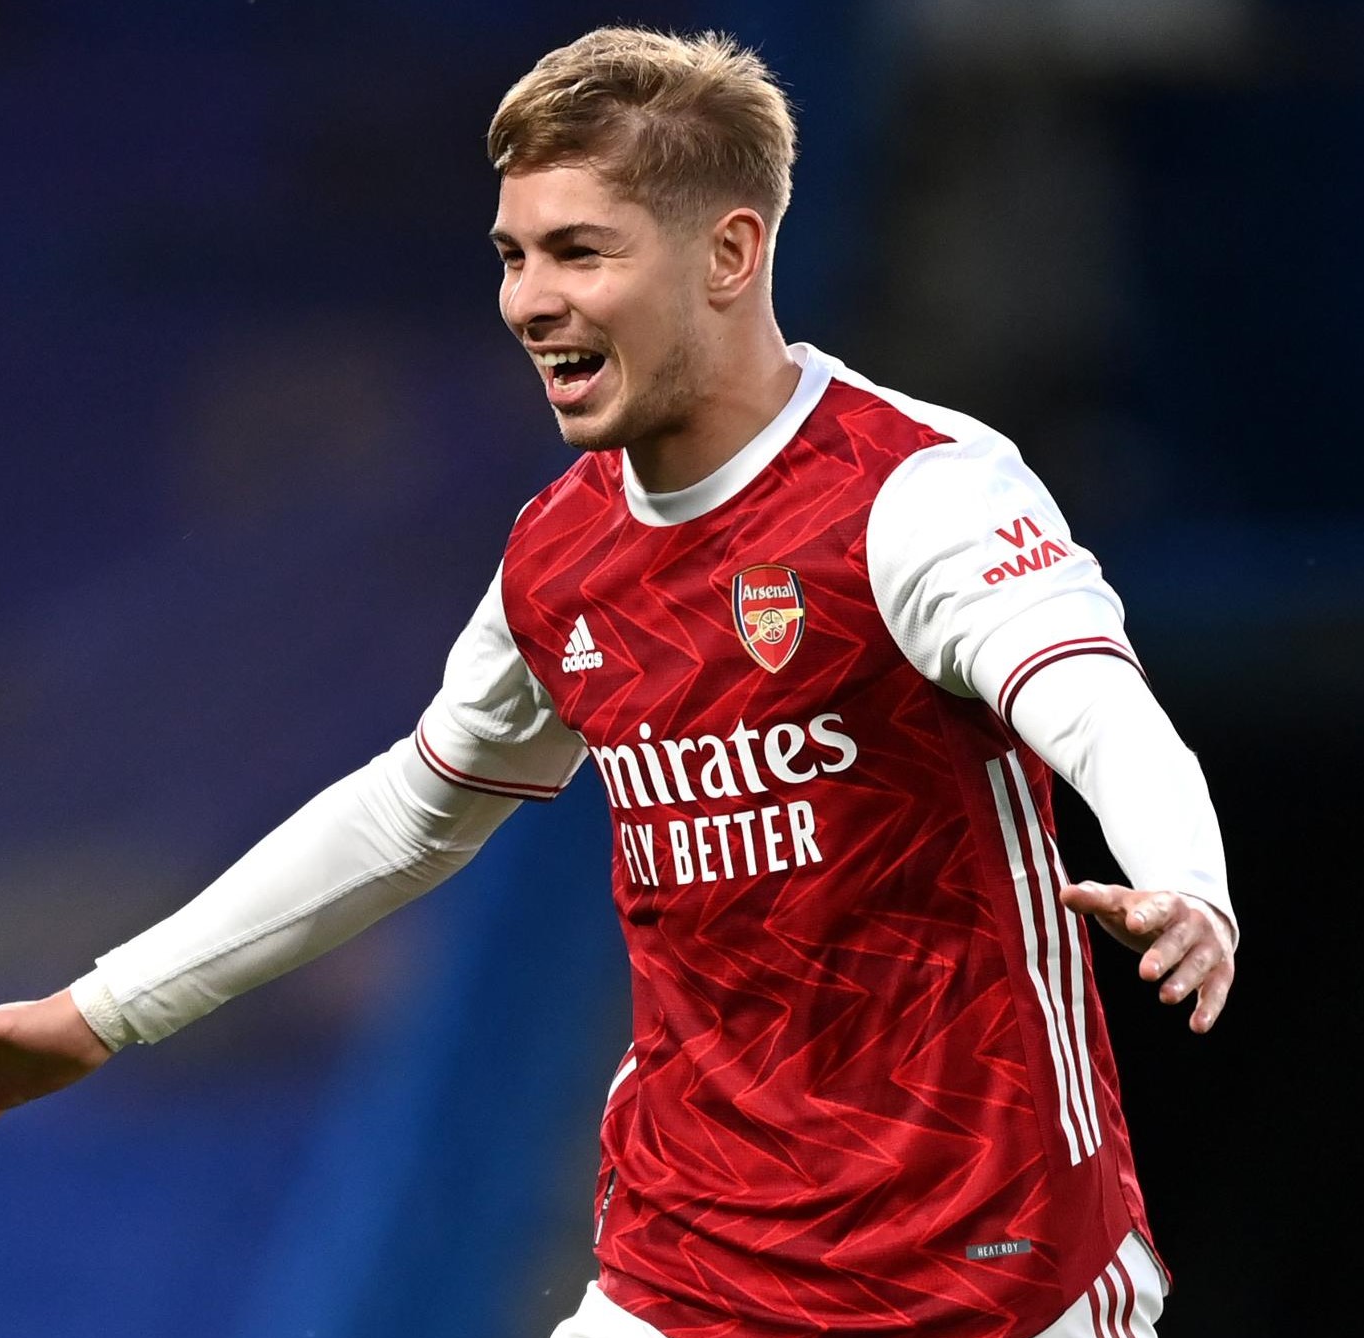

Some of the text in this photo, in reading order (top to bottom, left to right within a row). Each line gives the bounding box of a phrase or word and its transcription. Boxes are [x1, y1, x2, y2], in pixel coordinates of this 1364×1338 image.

[995, 516, 1042, 549] VI
[742, 581, 794, 601] Arsenal
[562, 651, 603, 673] adidas
[589, 713, 858, 809] mirates
[620, 800, 823, 887] FLY BETTER
[977, 1242, 1018, 1257] HEAT.RDY
